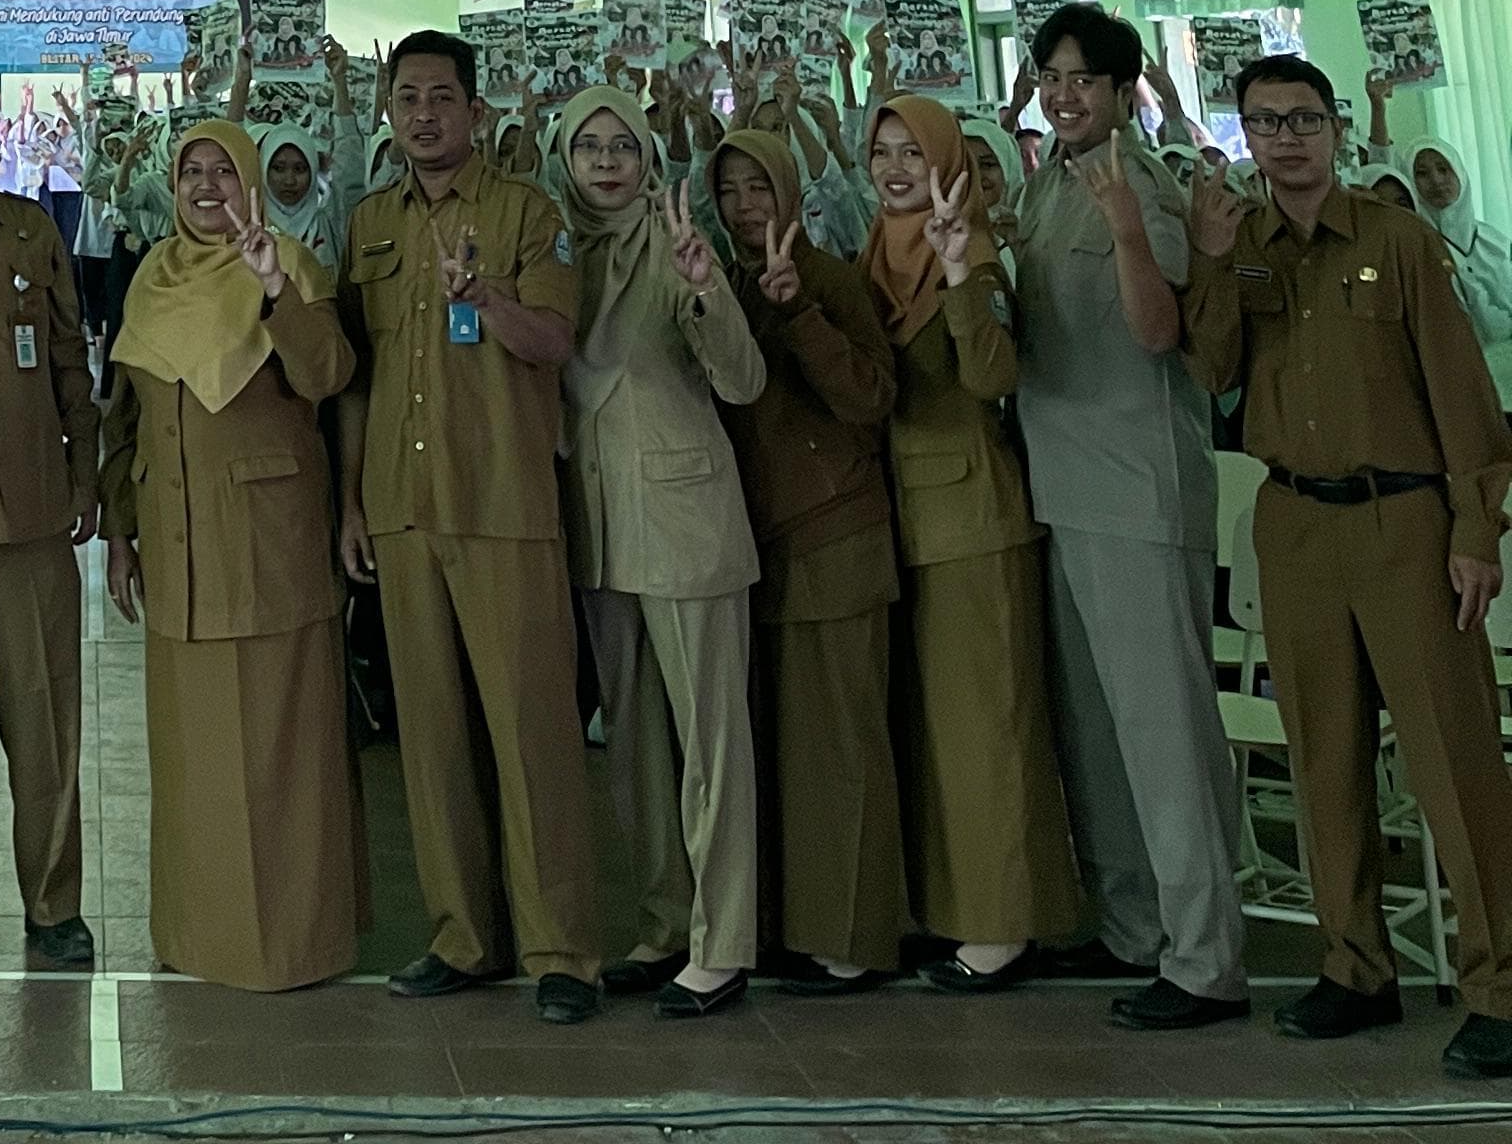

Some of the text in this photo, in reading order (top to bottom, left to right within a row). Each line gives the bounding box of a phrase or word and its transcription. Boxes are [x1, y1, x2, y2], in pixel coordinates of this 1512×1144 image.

[9, 5, 83, 26] Mendukung
[85, 6, 111, 23] anti
[114, 6, 185, 26] Perundung
[46, 27, 134, 44] di Jawa Timur
[41, 54, 80, 64] BLITAR
